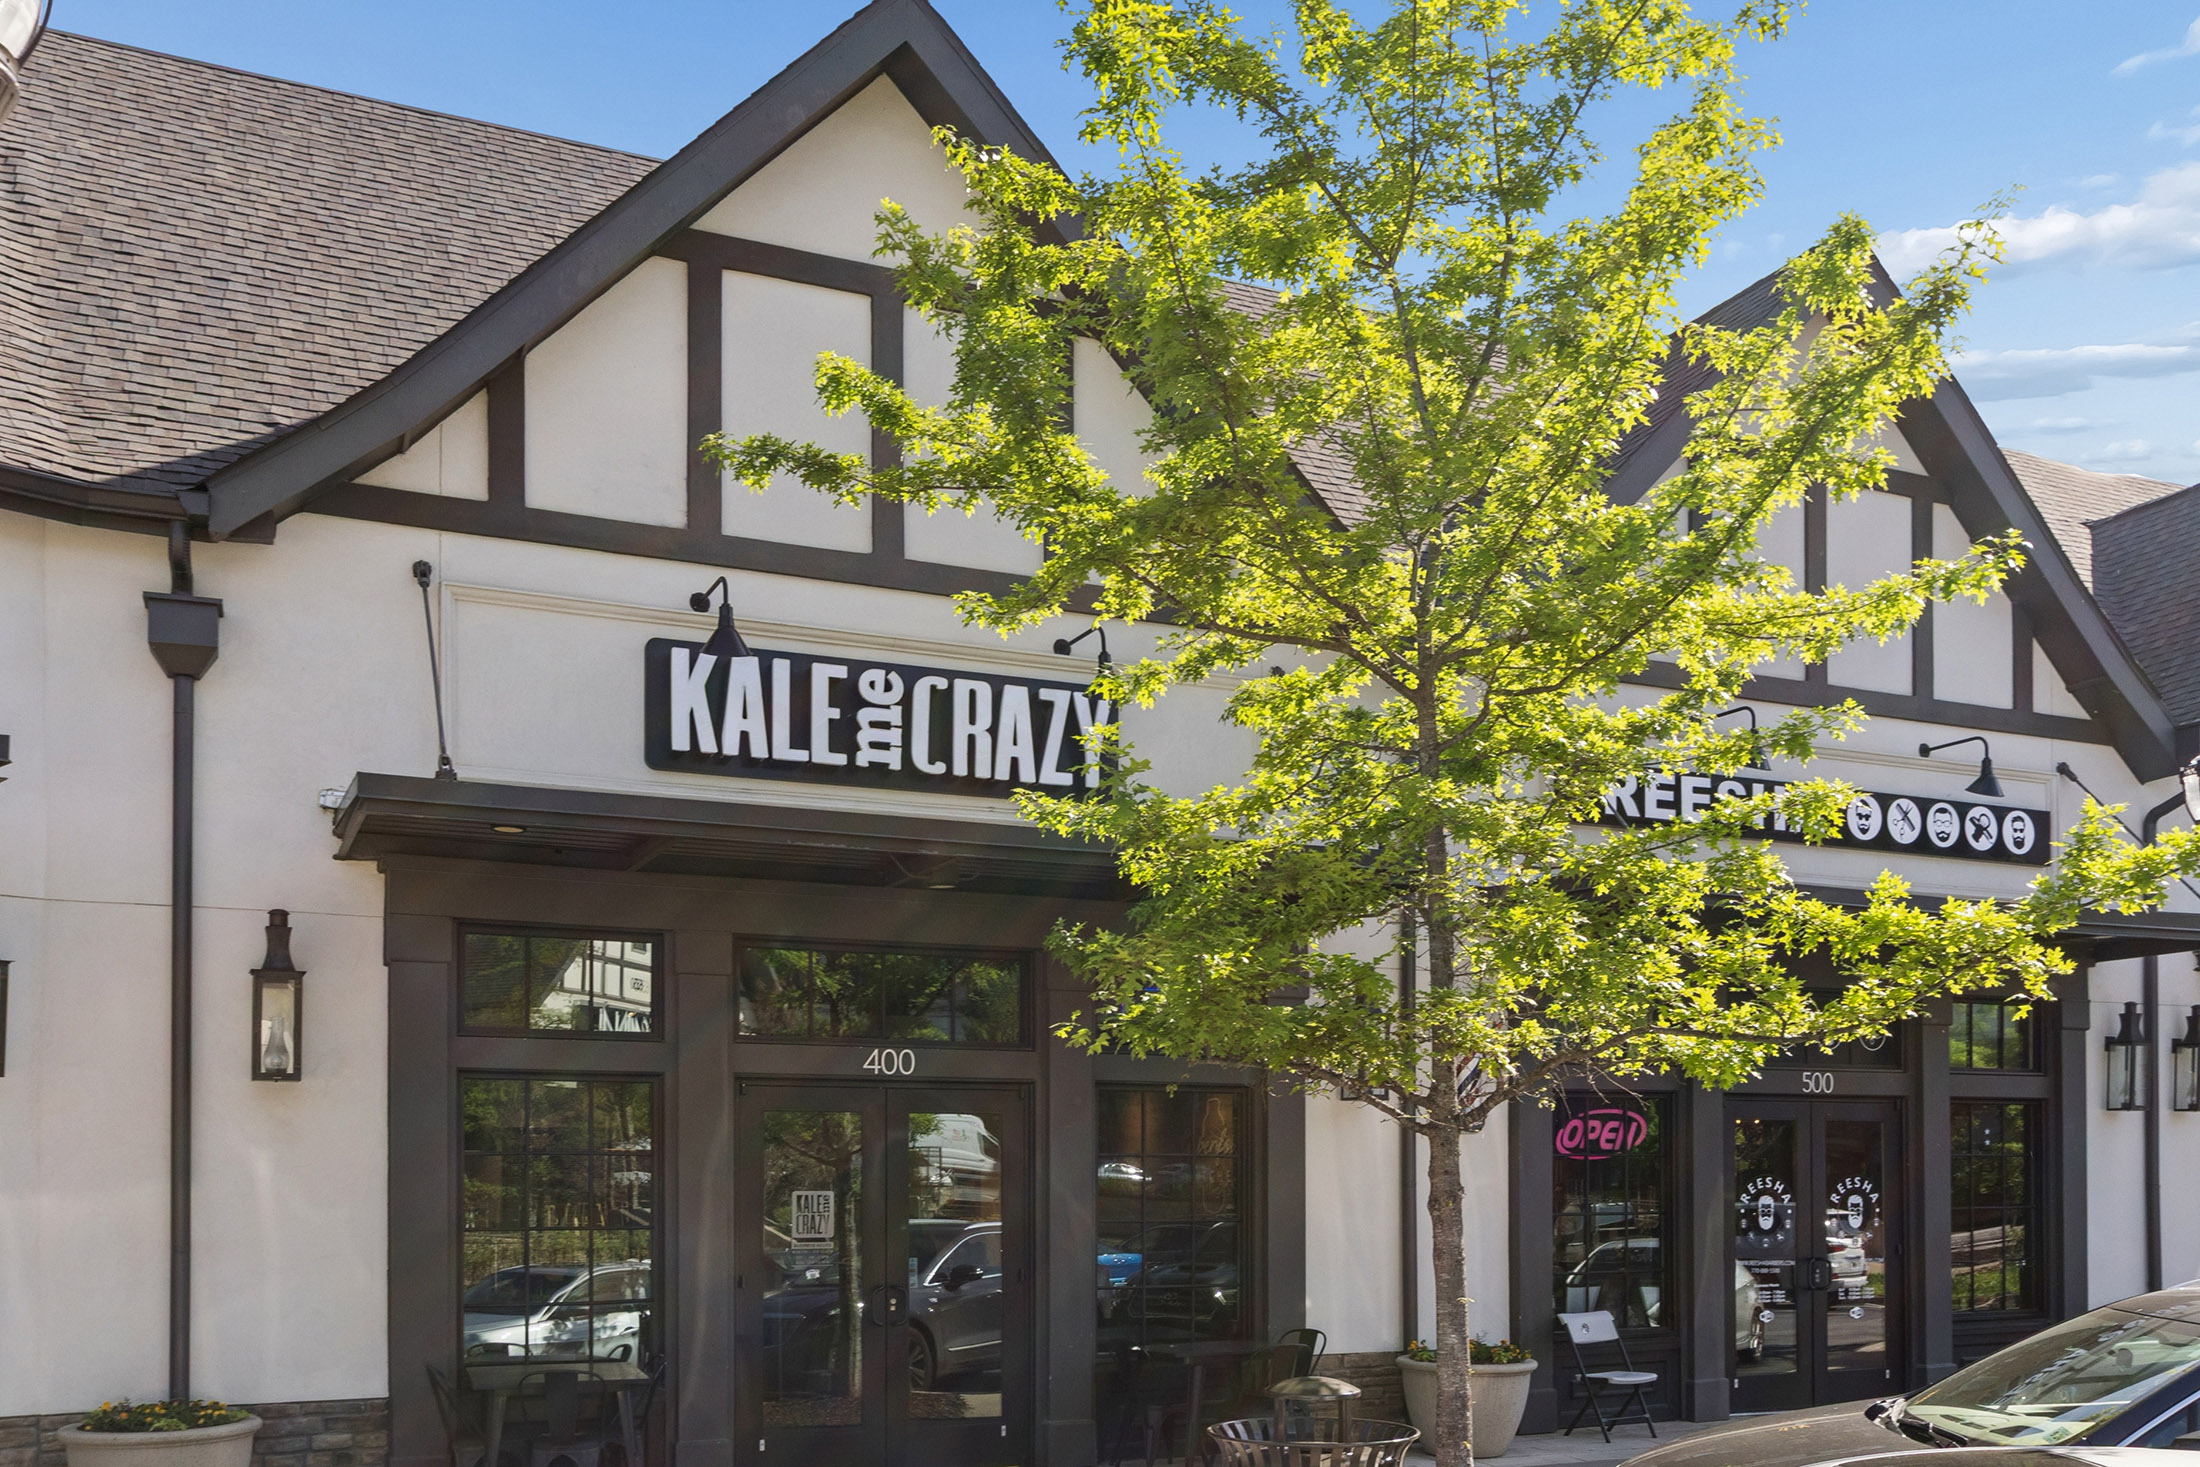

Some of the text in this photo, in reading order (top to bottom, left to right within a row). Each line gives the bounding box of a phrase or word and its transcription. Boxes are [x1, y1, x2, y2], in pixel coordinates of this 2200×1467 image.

[670, 647, 1110, 788] KALE me CRAZY
[862, 1048, 916, 1076] 400
[1801, 1071, 1834, 1094] 500
[1562, 1118, 1638, 1151] OPEN
[796, 1194, 823, 1214] KALE
[1740, 1176, 1791, 1204] REESHA
[1830, 1176, 1879, 1204] REESHA
[796, 1214, 831, 1235] CRAZY
